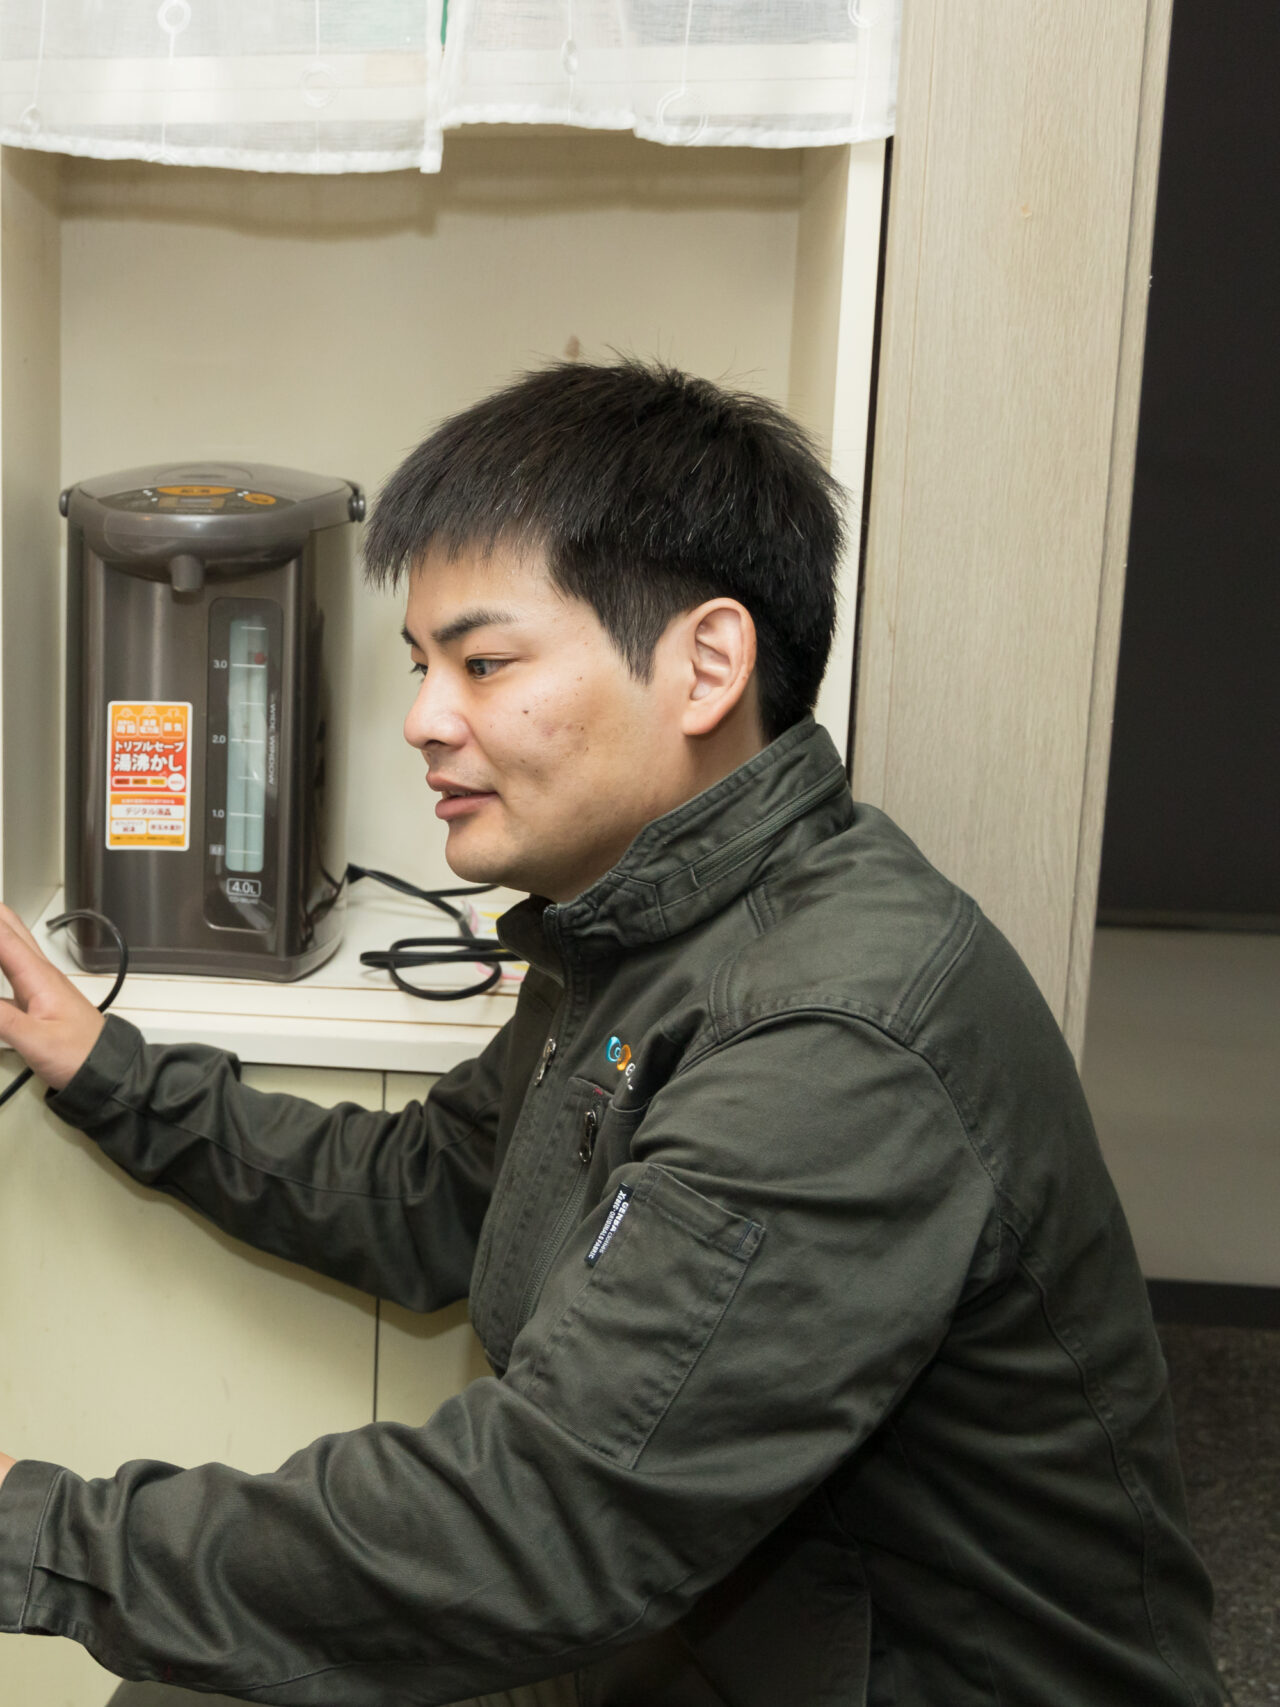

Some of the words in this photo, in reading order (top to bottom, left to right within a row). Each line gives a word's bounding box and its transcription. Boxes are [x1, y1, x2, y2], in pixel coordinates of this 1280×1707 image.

[213, 659, 228, 669] 3.0
[212, 735, 226, 745] 2.0
[115, 741, 185, 752] トリプルセーブ
[114, 754, 183, 772] 湯沸かし
